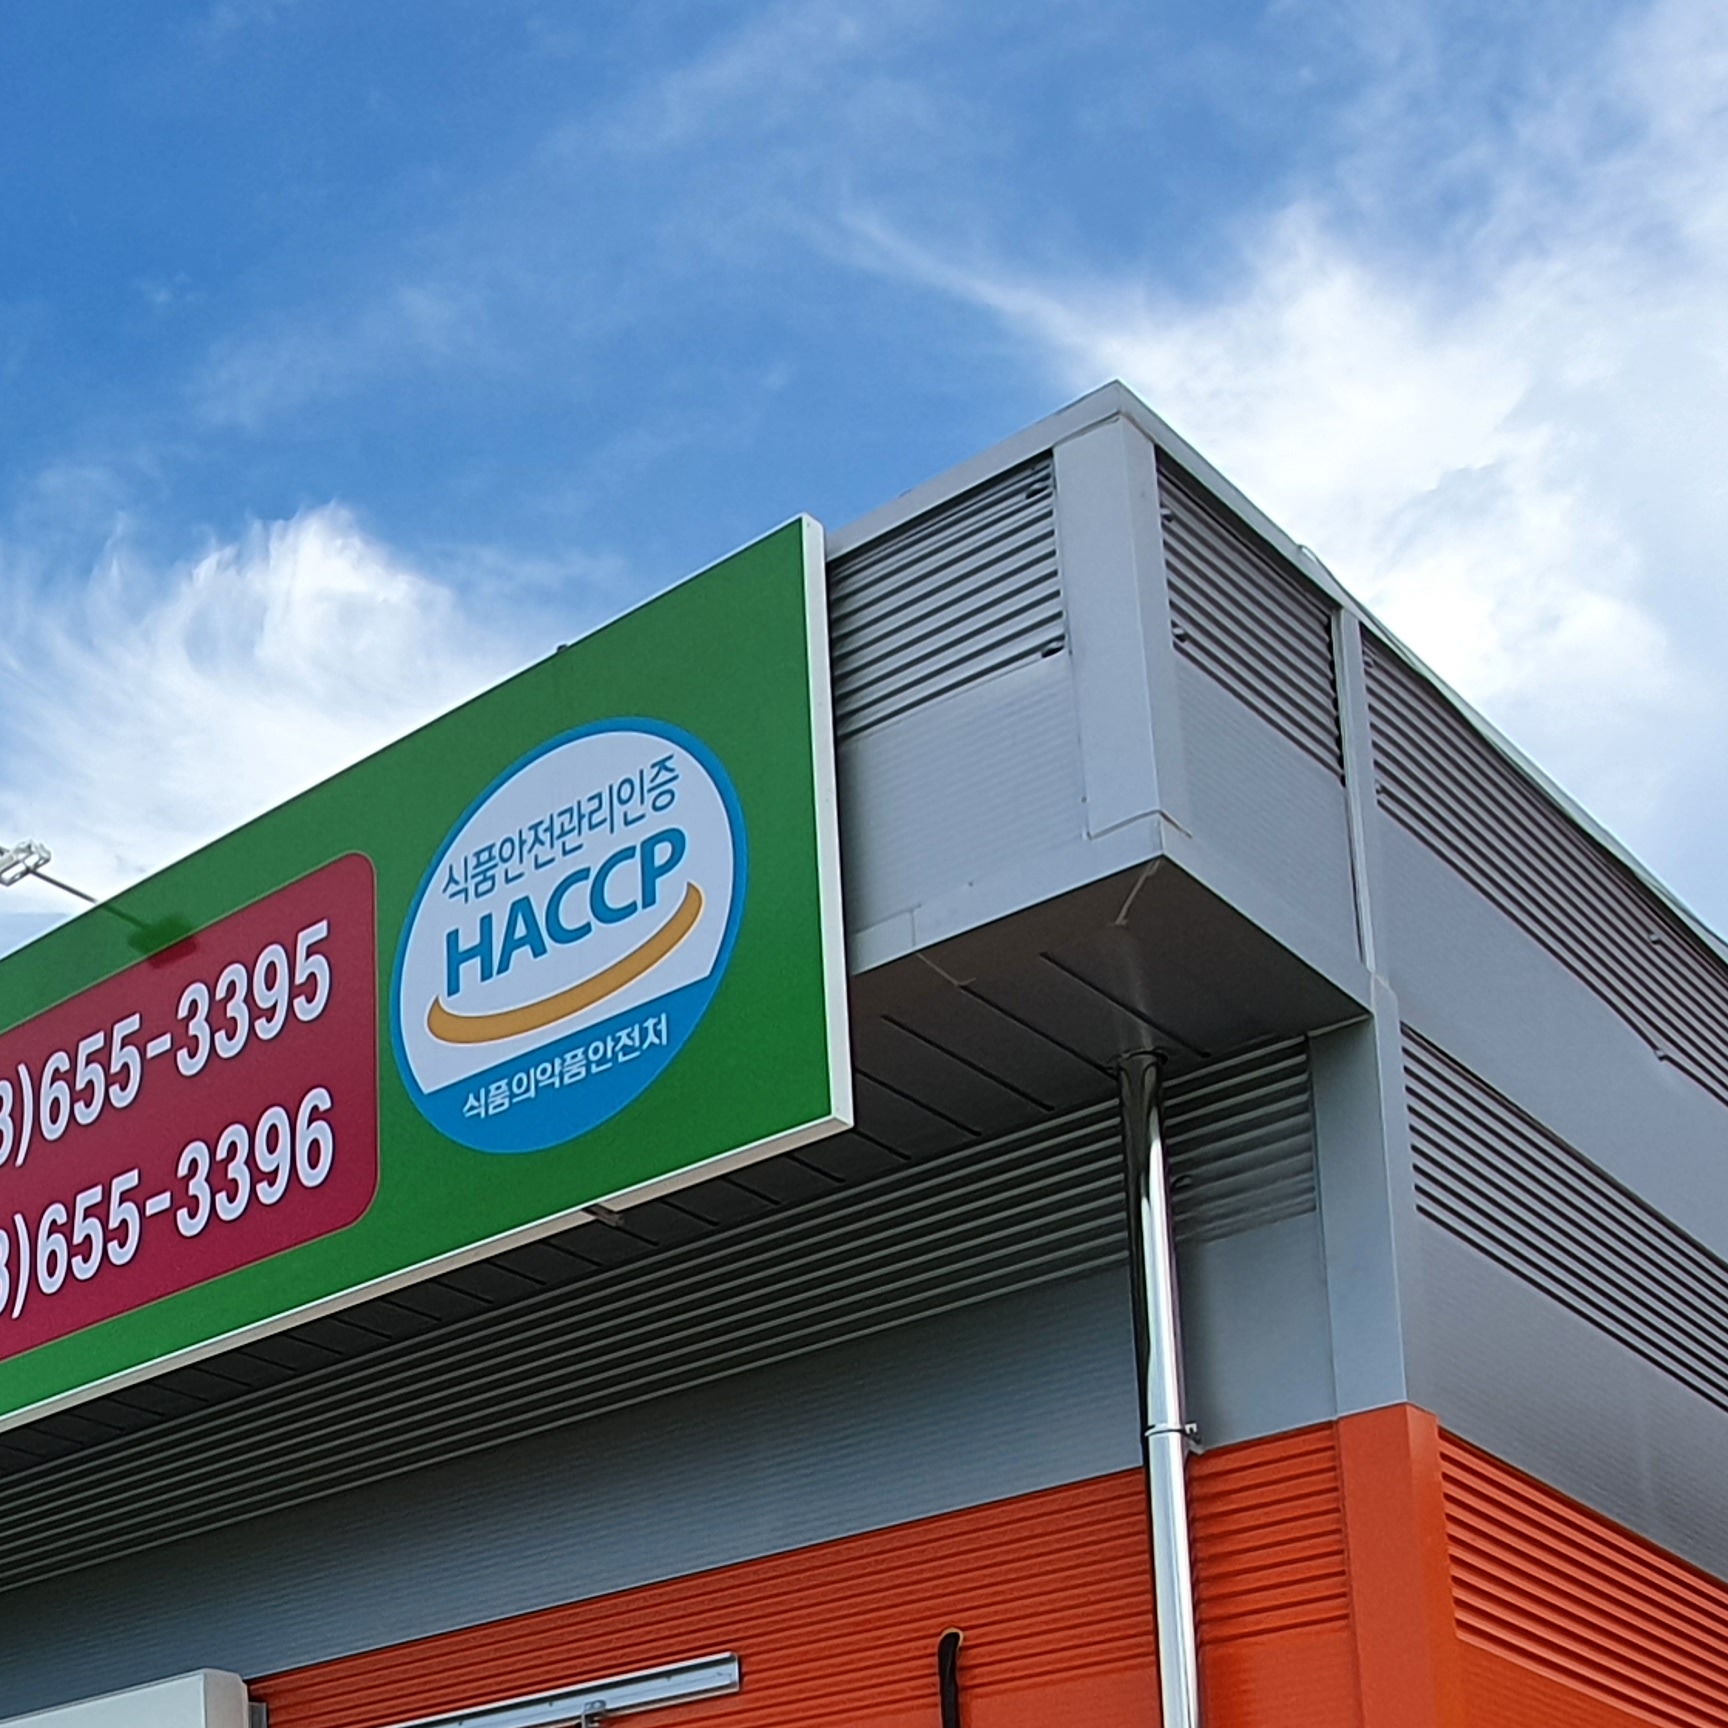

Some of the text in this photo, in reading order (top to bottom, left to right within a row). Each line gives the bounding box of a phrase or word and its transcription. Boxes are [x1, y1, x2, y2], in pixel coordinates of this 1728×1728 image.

[442, 754, 679, 904] 식품안전관리인증
[446, 828, 687, 997] HACCP
[462, 1013, 669, 1119] 식품의약품안전처
